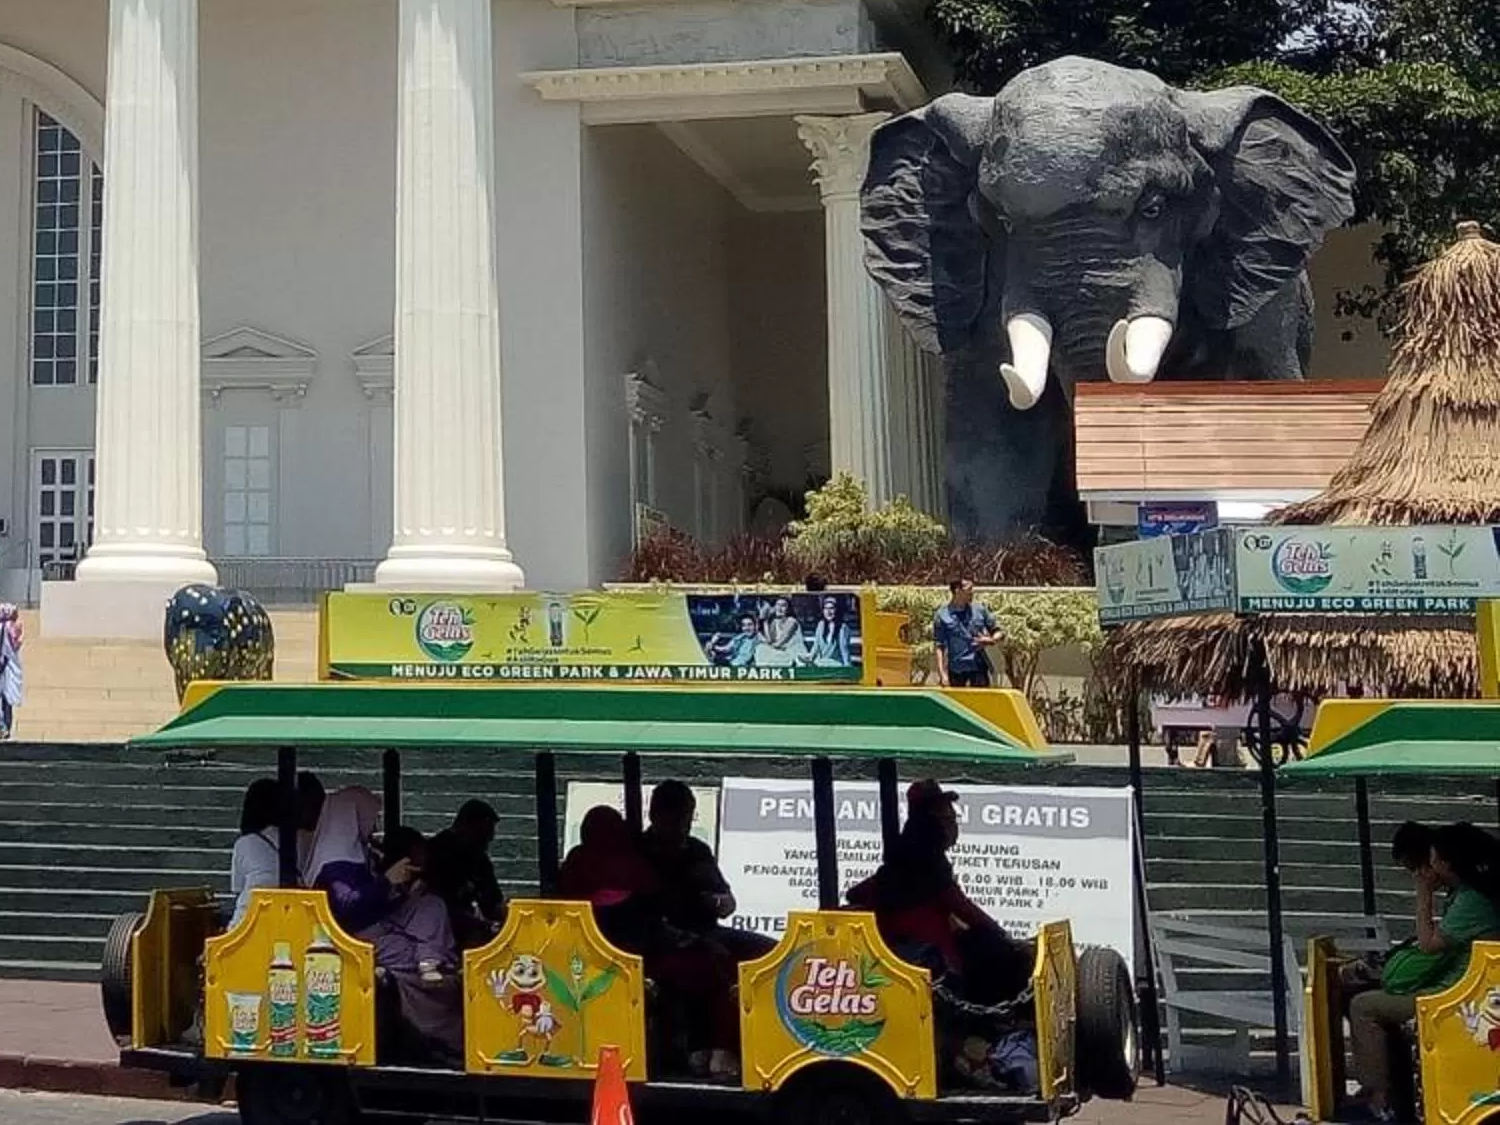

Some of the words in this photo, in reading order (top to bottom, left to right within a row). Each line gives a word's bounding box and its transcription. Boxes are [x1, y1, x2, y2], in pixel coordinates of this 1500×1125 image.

[1249, 597, 1315, 609] MENUJU
[1321, 598, 1355, 609] ECO
[1361, 598, 1418, 610] GREEN
[1425, 598, 1471, 610] PARK
[392, 665, 457, 677] MENUJU
[462, 666, 495, 678] ECO
[500, 666, 554, 679] GREEN
[560, 666, 603, 679] PARK
[626, 666, 673, 679] JAWA
[679, 666, 732, 680] TIMUR
[737, 667, 784, 680] PARK
[788, 668, 796, 680] 1
[981, 804, 1091, 828] GRATIS
[995, 858, 1061, 870] TERUSAN
[1006, 888, 1039, 897] PARK
[804, 958, 857, 989] Teh
[790, 986, 878, 1015] Gelas
